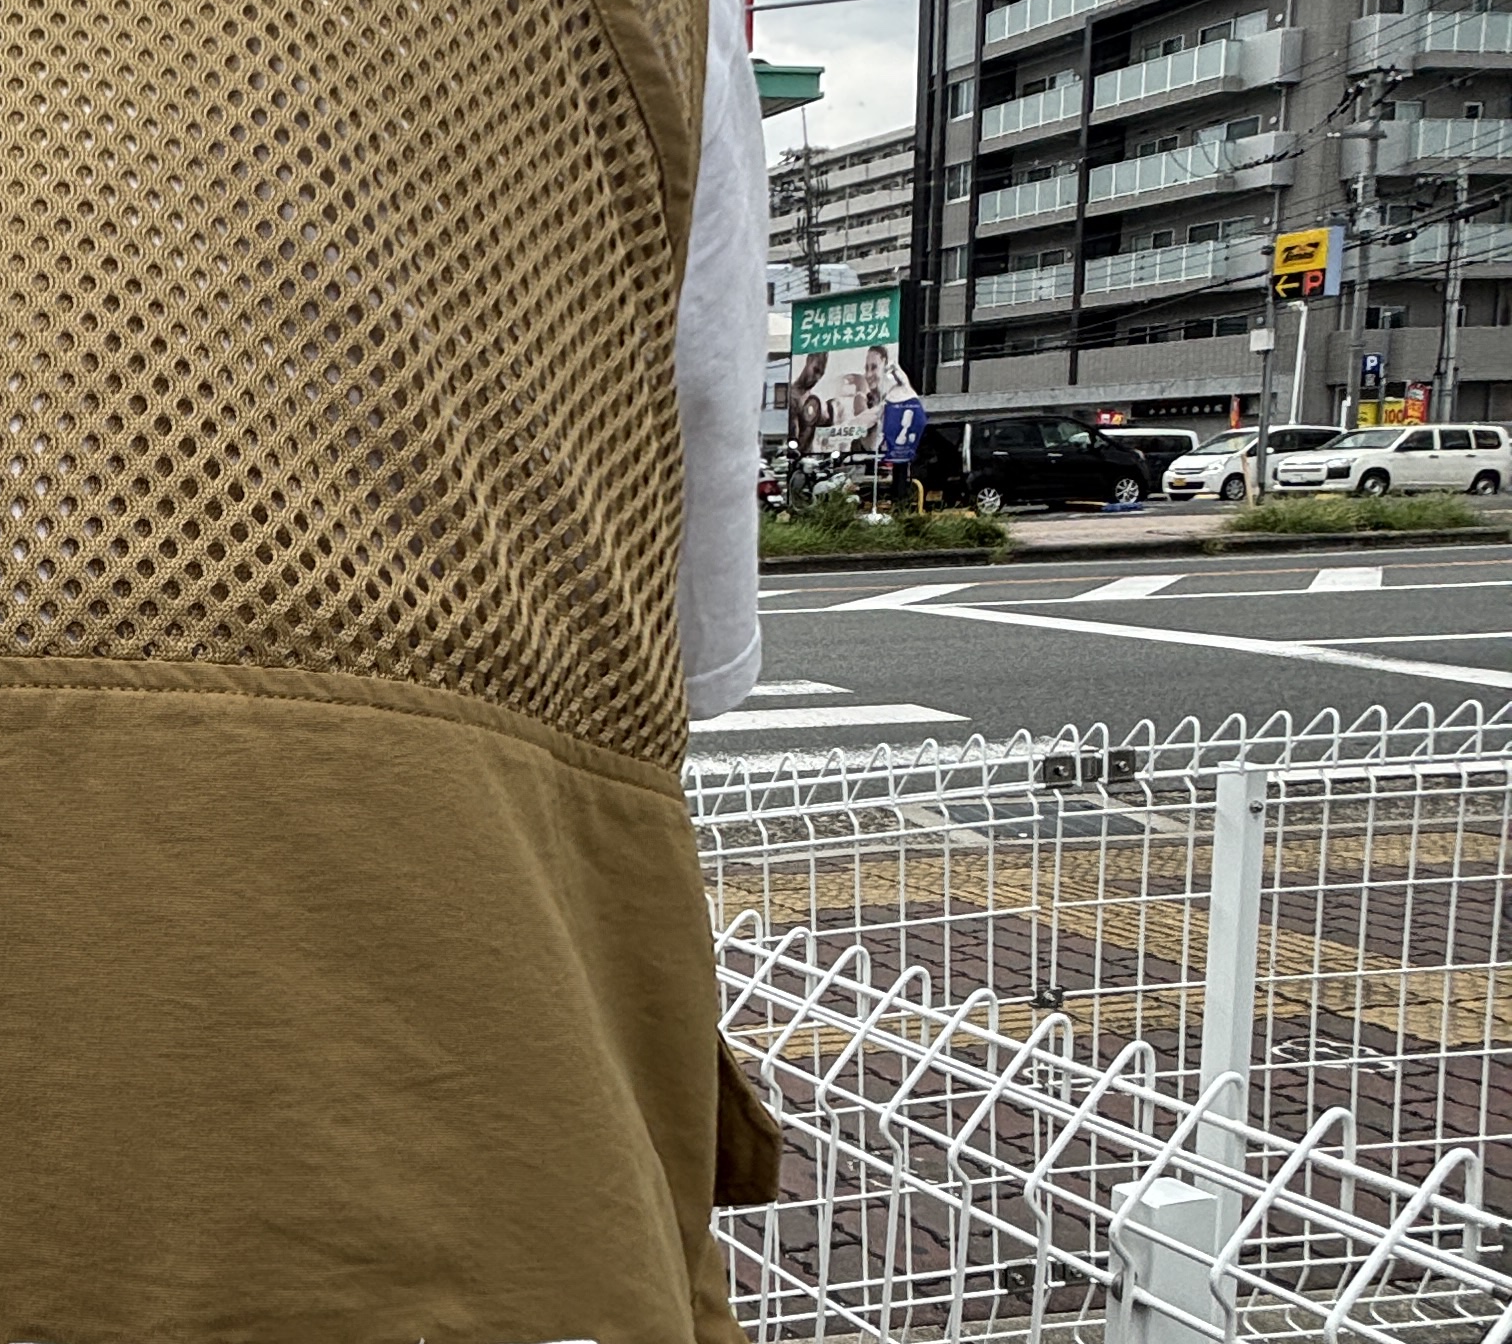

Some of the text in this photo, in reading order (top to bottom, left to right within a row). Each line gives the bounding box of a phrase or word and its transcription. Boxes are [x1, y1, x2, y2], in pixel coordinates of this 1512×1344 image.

[1303, 270, 1323, 296] P
[800, 297, 891, 330] 24時間営業
[800, 322, 890, 348] フィットネスジム
[1366, 355, 1378, 371] P
